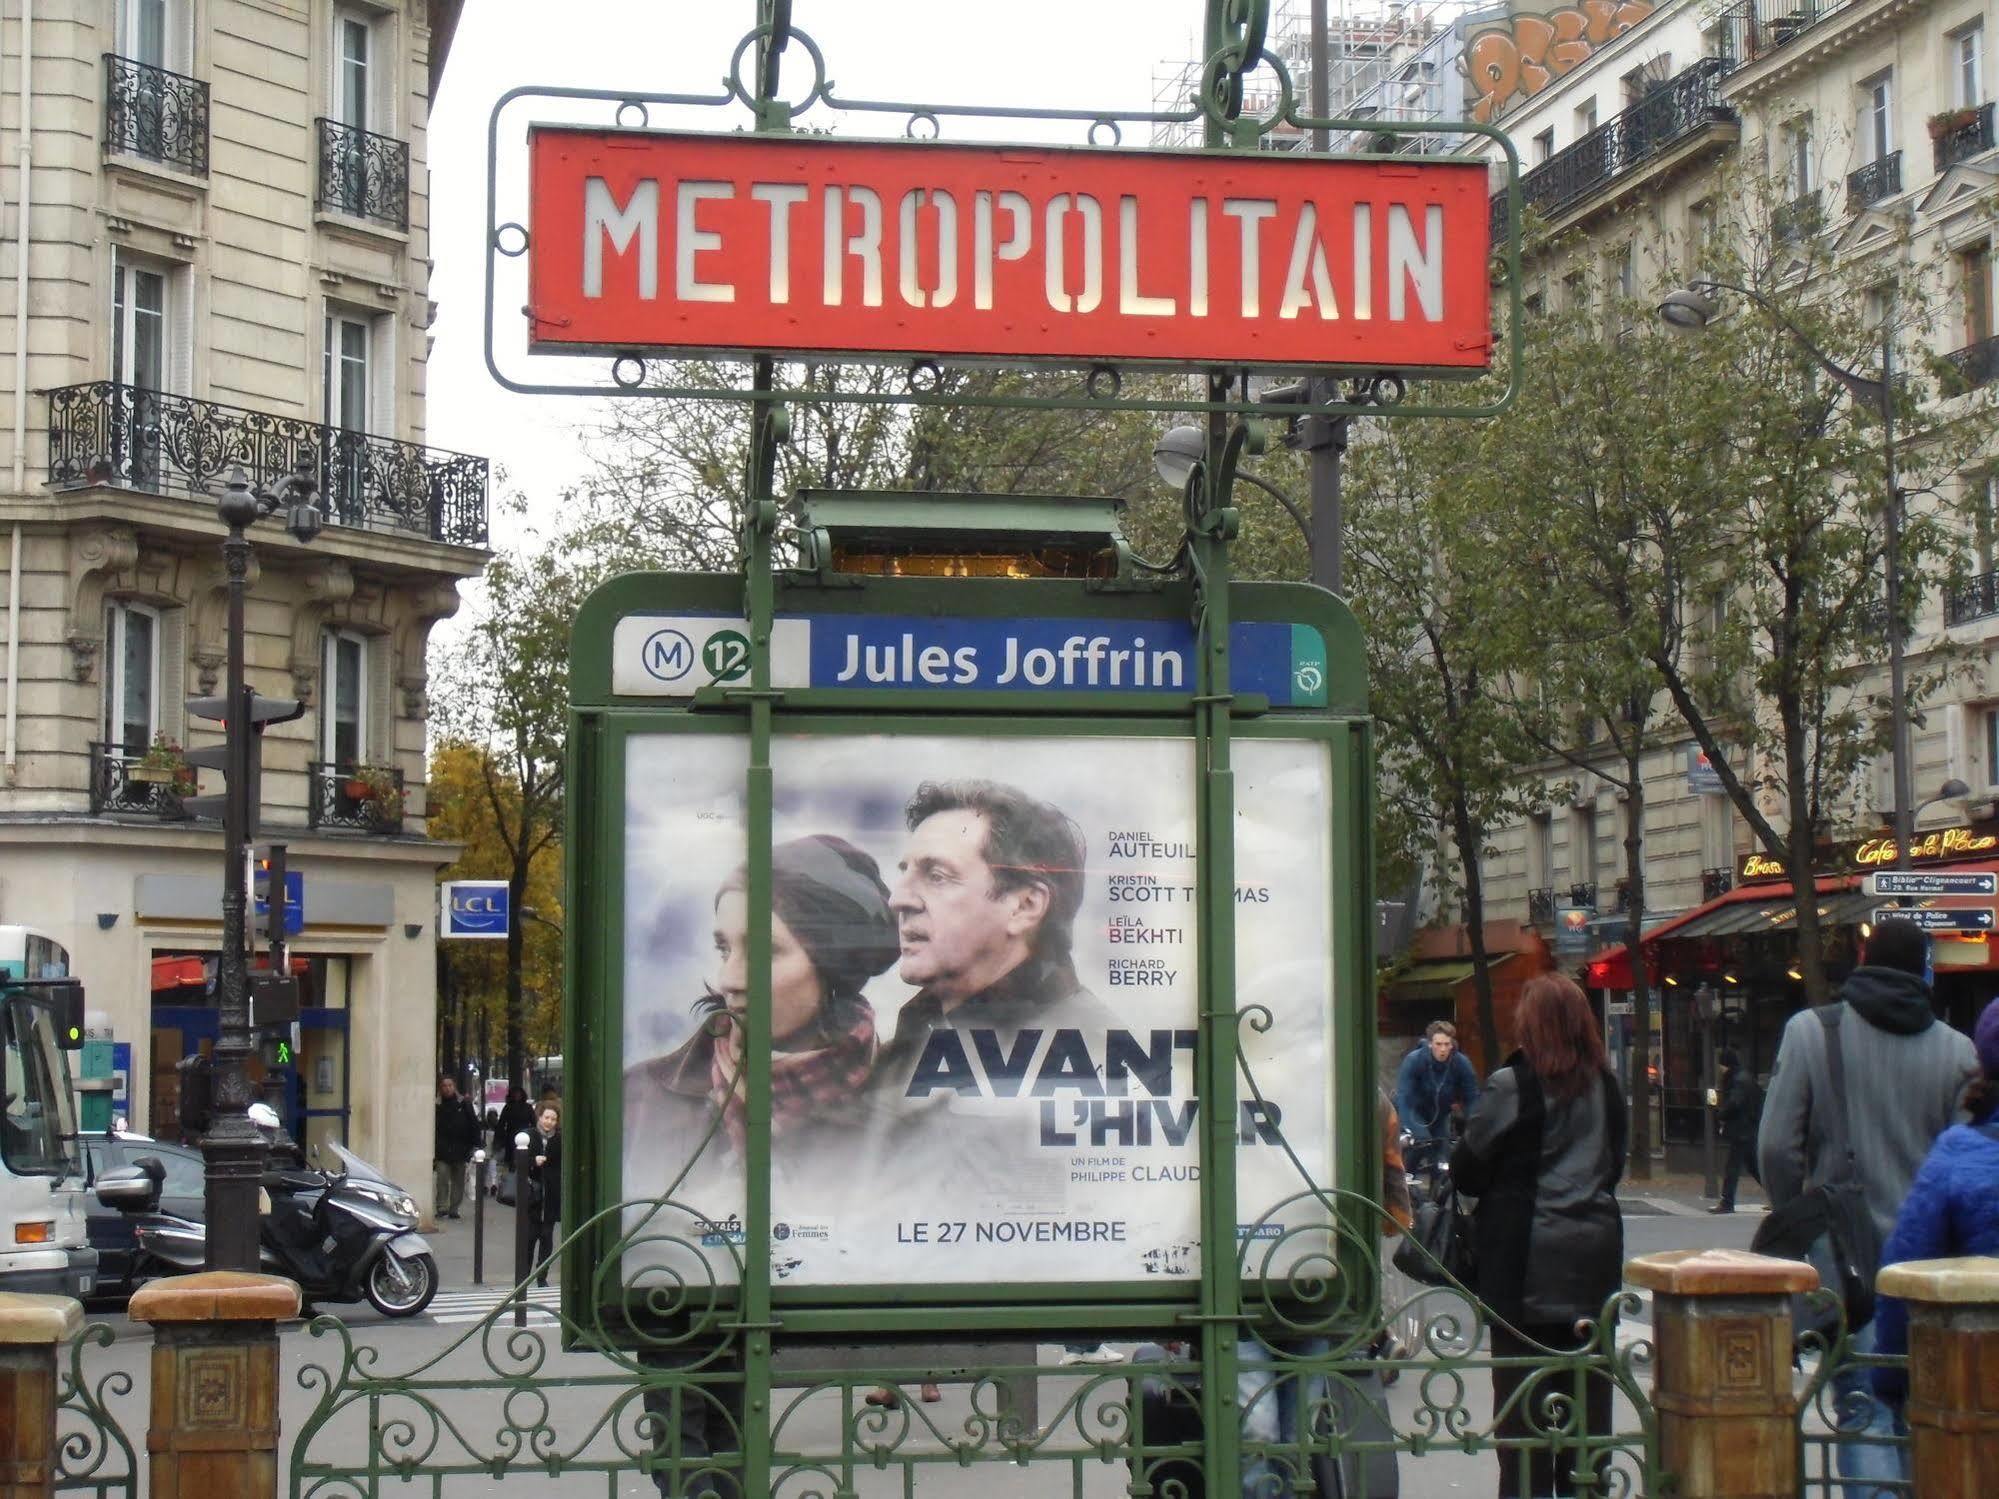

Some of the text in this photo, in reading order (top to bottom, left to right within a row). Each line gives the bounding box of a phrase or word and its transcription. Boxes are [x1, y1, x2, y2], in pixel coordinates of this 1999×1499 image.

[582, 176, 1445, 323] METROPOLITAIN
[707, 640, 746, 671] 12
[837, 633, 1183, 687] Jules Joffrin
[1108, 832, 1154, 842] DANIEL
[1109, 843, 1197, 858] AUTEUIL
[1856, 838, 1898, 865] Café
[1108, 875, 1157, 886] KRISTIN
[1109, 887, 1270, 902] SCOTT TMAS
[453, 897, 501, 912] LCL
[1108, 915, 1144, 927] LEÏLA
[1109, 929, 1183, 943] BEKHTI
[1108, 959, 1165, 969] RICHARD
[1109, 971, 1178, 985] BERRY
[1040, 1100, 1284, 1146] L'HIVR
[1071, 1158, 1126, 1166] UN FILM DE
[1071, 1172, 1126, 1182] PHILIPPE
[897, 1221, 1127, 1243] LE 27 NOVEMBRE
